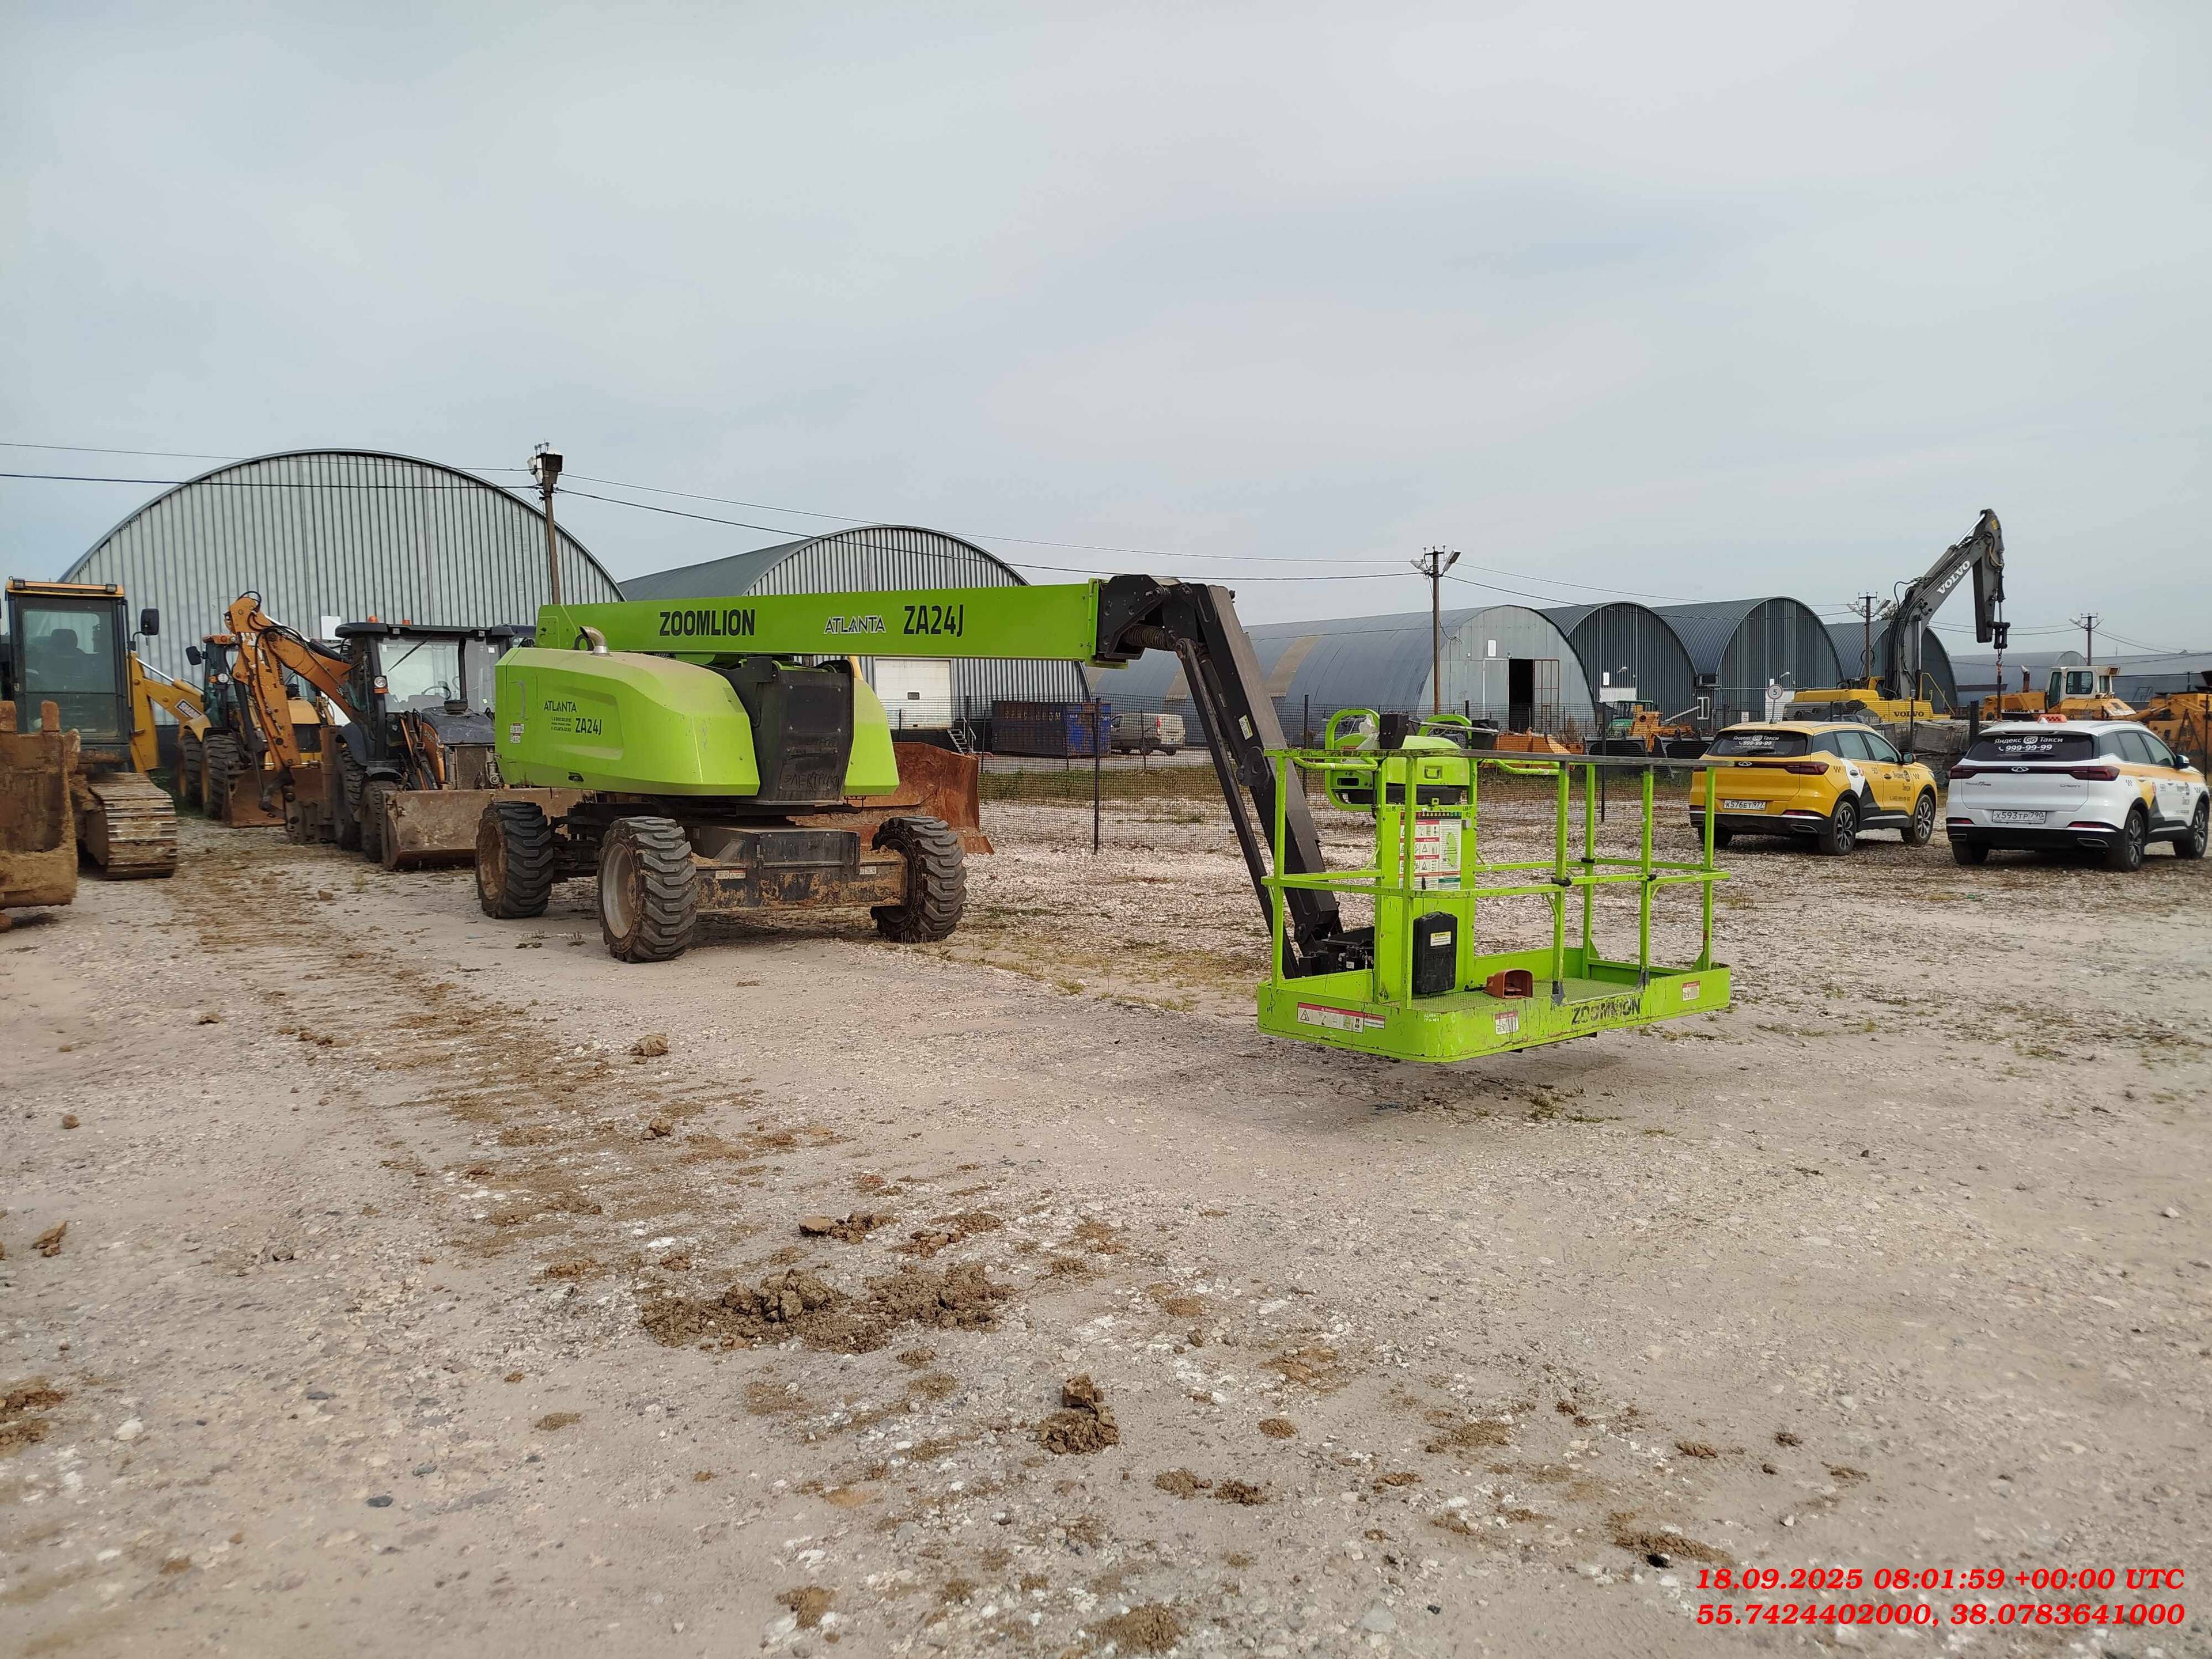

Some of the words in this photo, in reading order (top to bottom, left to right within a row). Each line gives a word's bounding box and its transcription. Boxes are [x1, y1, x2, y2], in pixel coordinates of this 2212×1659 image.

[1937, 560, 1970, 594] VOLVO
[658, 609, 756, 637] ZOOMLION
[824, 615, 886, 634] ATLANTA
[903, 604, 964, 637] ZA24J
[543, 700, 577, 713] ATLANTA
[575, 718, 602, 736] ZA24J
